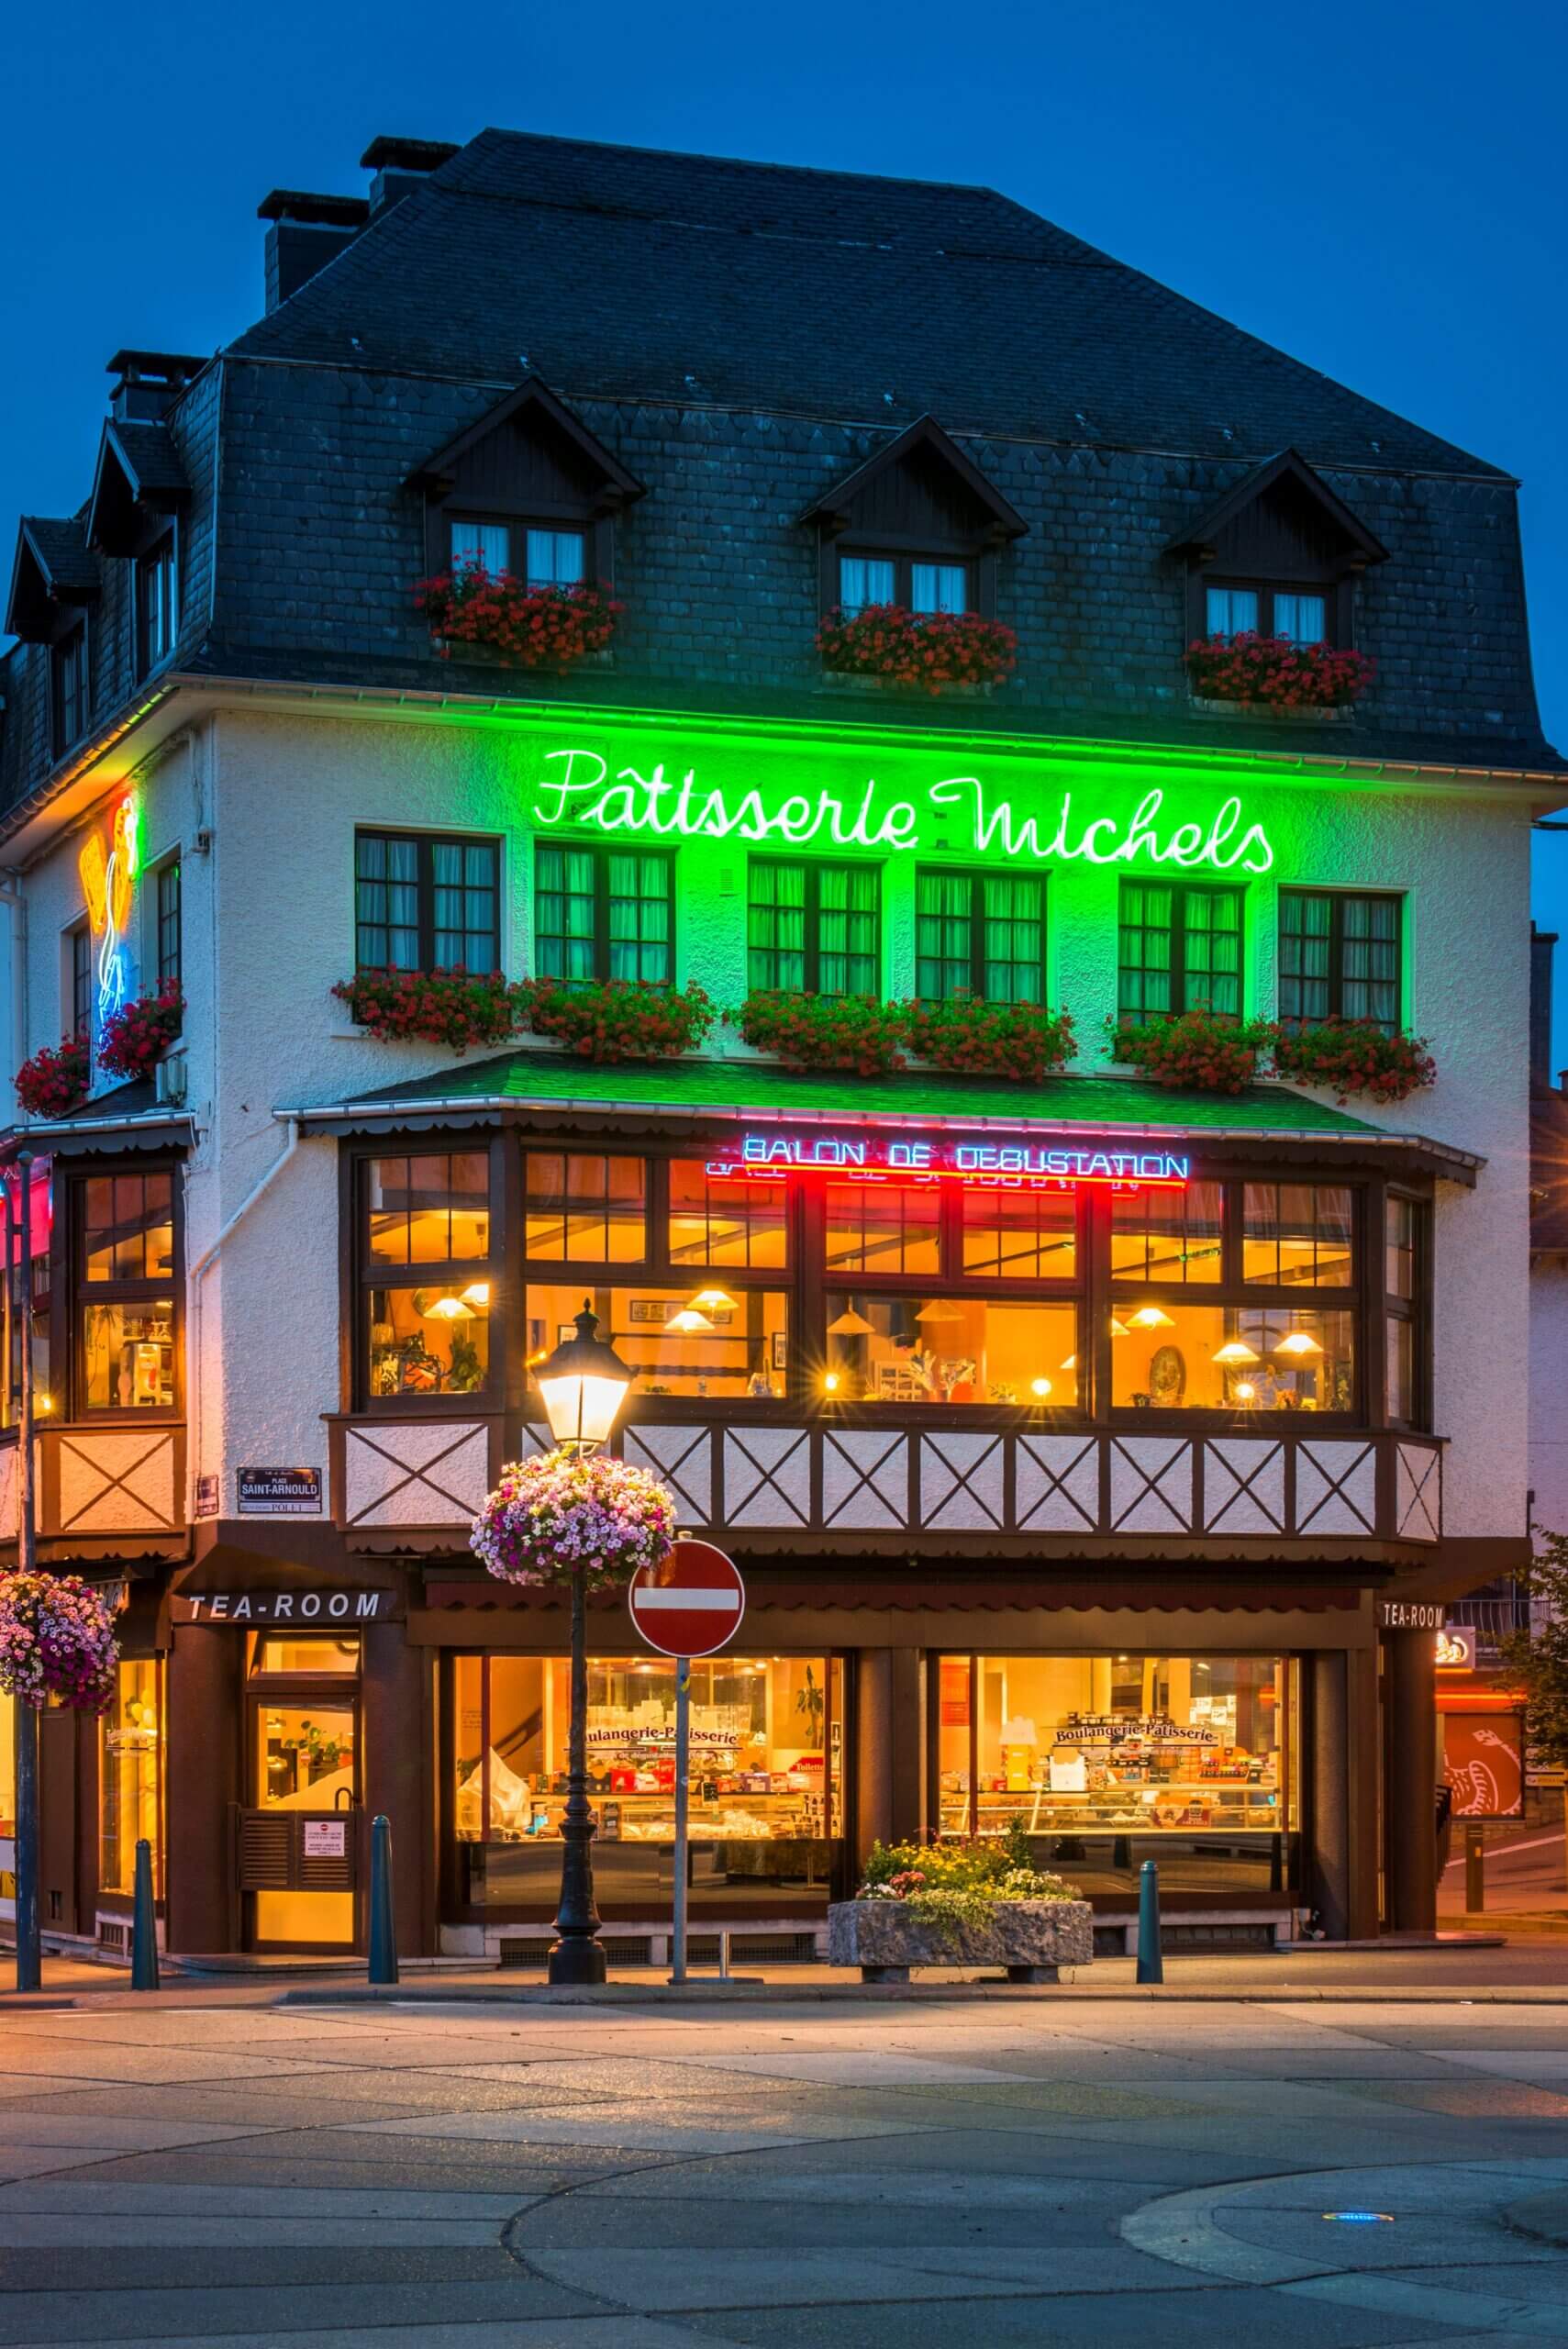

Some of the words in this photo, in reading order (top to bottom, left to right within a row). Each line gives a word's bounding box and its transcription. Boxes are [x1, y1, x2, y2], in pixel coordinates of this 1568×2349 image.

[929, 777, 1274, 874] Michels
[241, 1483, 318, 1496] SAINT-ARNOULD
[189, 1593, 380, 1620] TEA-ROOM
[1384, 1603, 1444, 1629] TEA-ROOM
